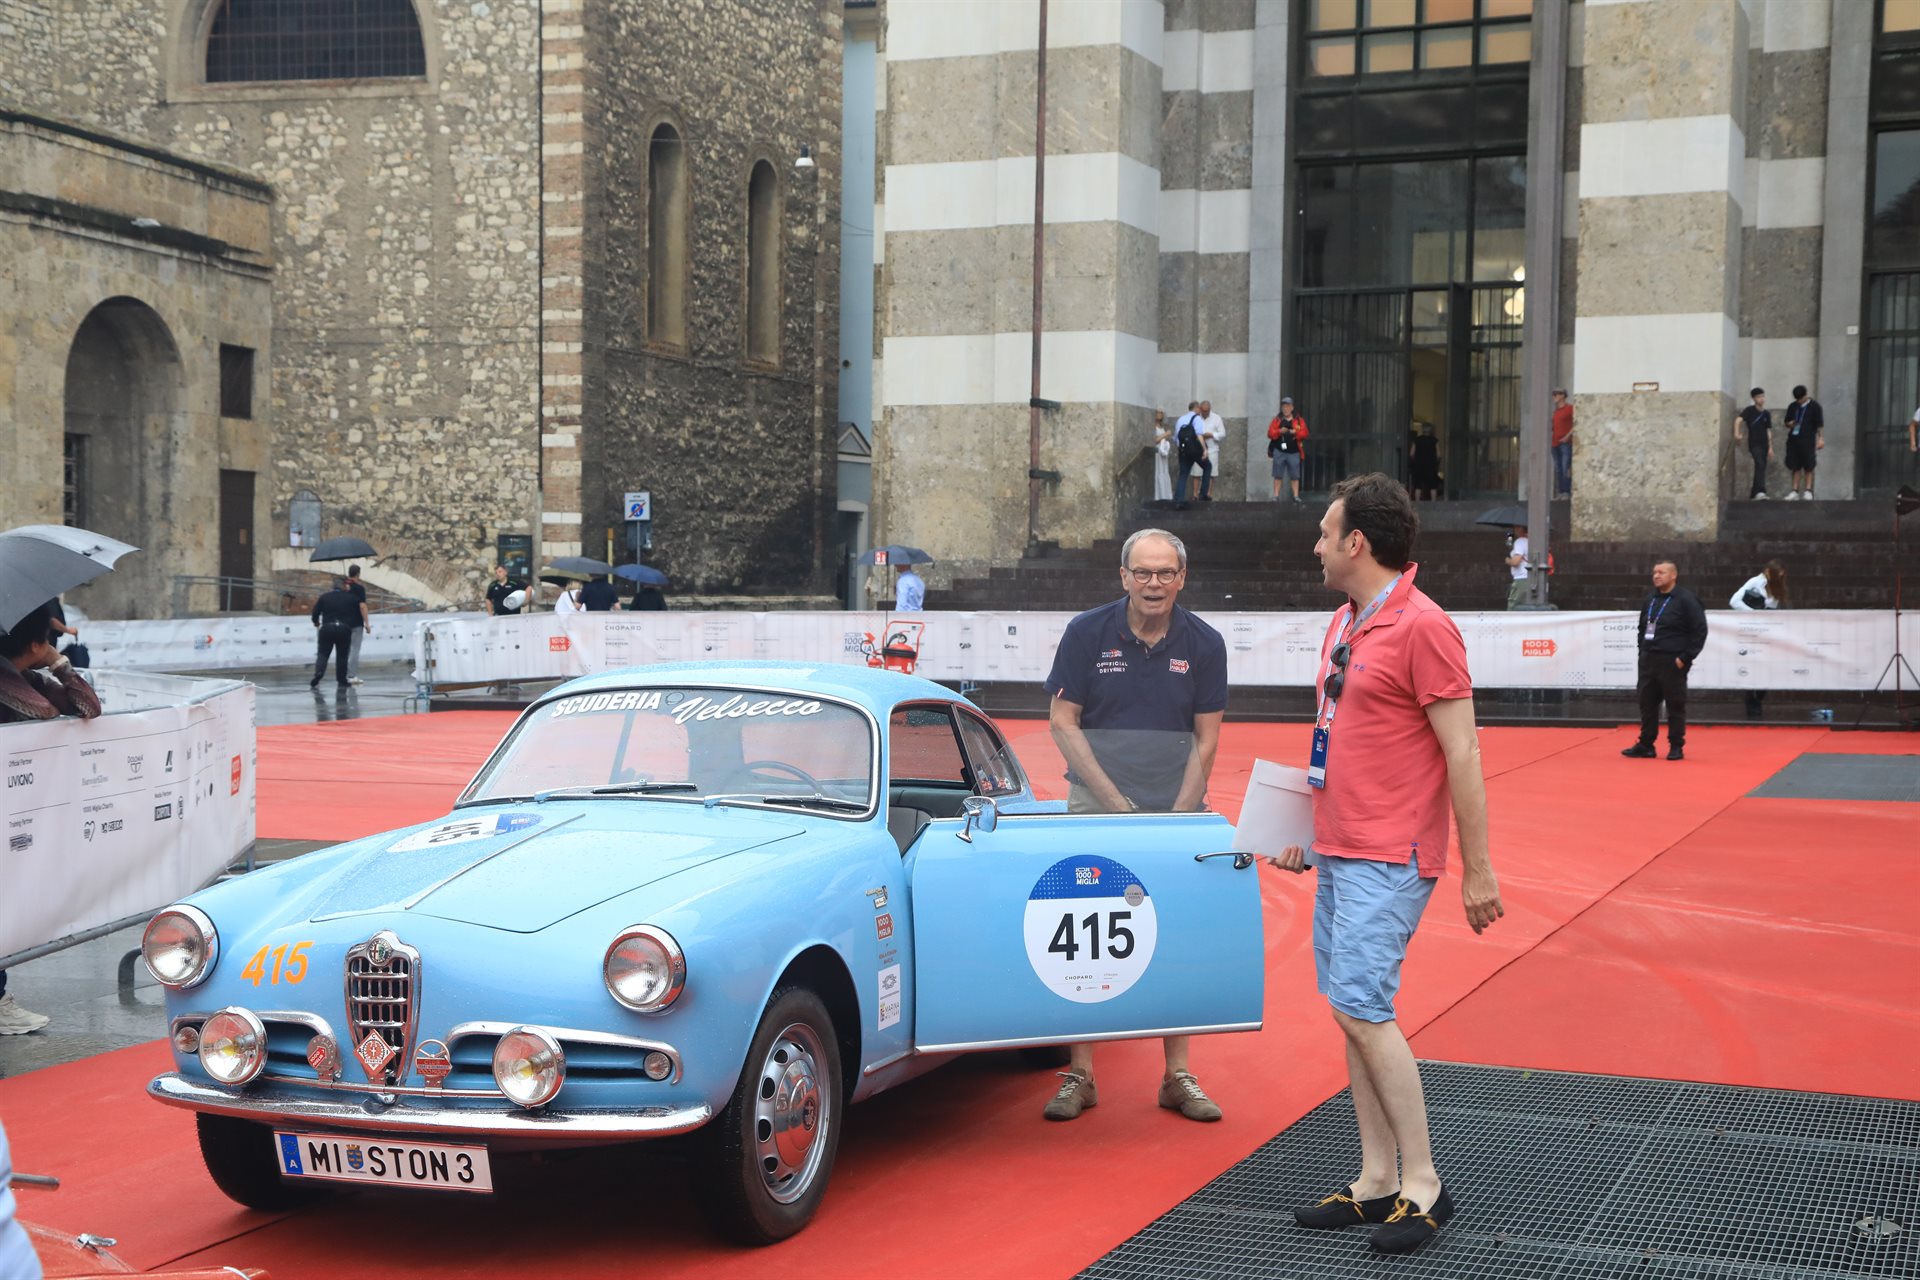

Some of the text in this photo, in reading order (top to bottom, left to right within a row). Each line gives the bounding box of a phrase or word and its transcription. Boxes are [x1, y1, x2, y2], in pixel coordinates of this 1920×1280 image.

[551, 692, 824, 725] SCUDERIA Velsecco
[8, 772, 34, 788] LIVIGNO
[1075, 871, 1092, 879] 1000
[1048, 911, 1135, 961] 415
[240, 941, 315, 987] 415
[289, 1159, 298, 1169] A
[308, 1141, 475, 1183] MI STON 3
